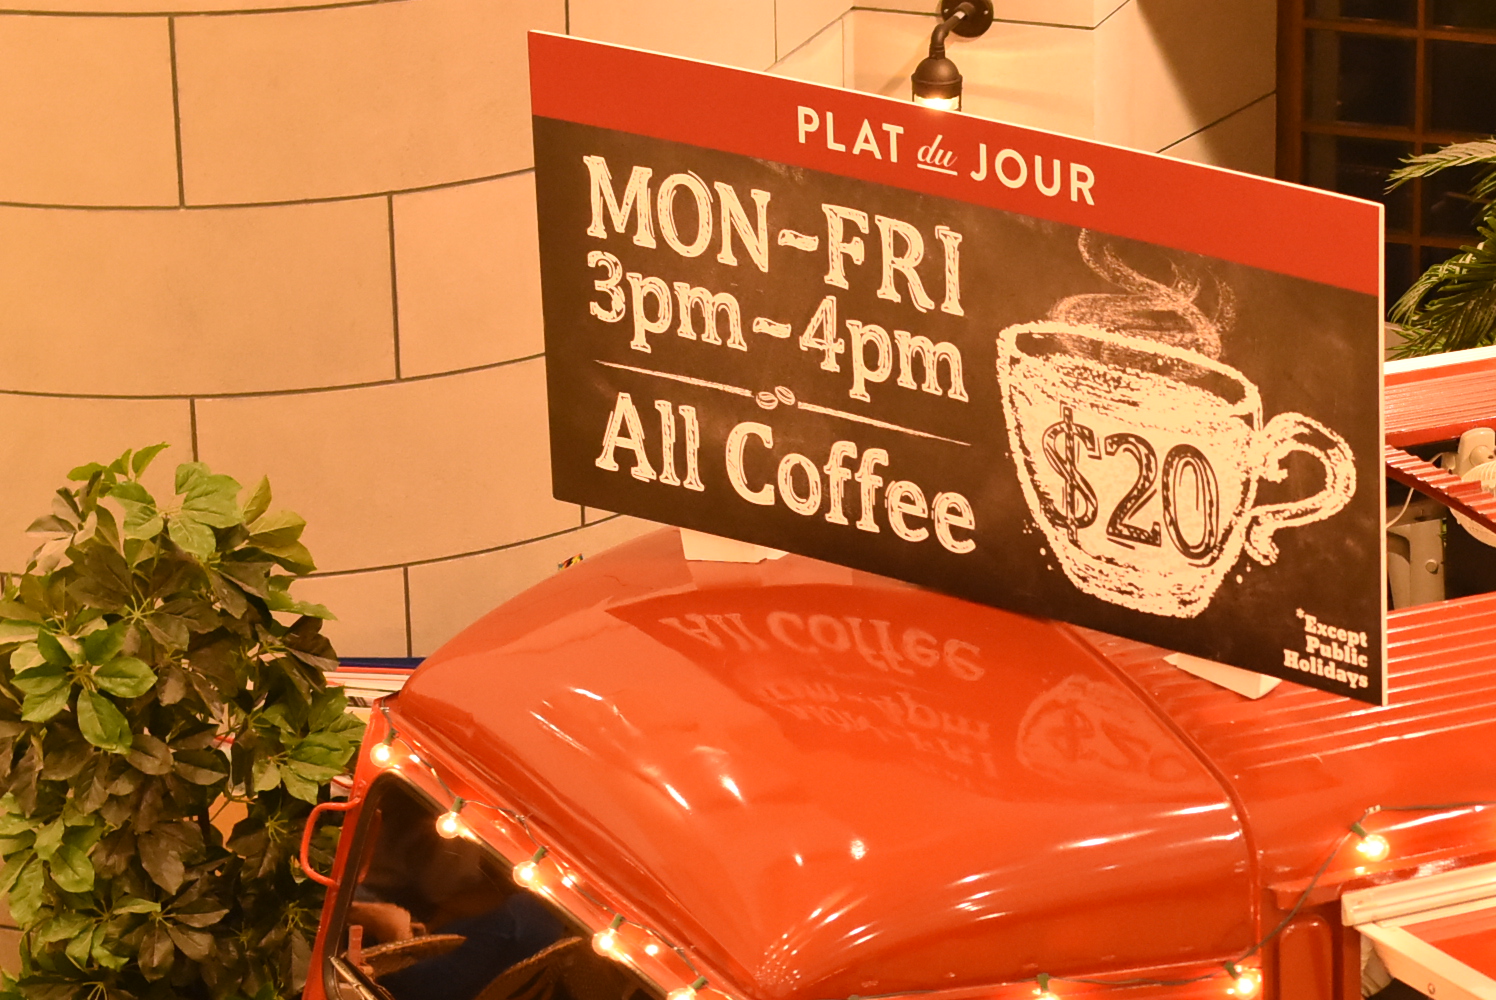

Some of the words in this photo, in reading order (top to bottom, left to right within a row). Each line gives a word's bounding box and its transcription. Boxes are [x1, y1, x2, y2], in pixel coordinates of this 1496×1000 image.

[797, 105, 904, 163] PLAT
[916, 134, 958, 175] du
[970, 142, 1096, 206] JOUR
[595, 391, 705, 492] All
[725, 421, 976, 553] Coffee
[1041, 400, 1220, 567] $20
[1283, 649, 1368, 689] Holidays
[1305, 635, 1368, 668] Public
